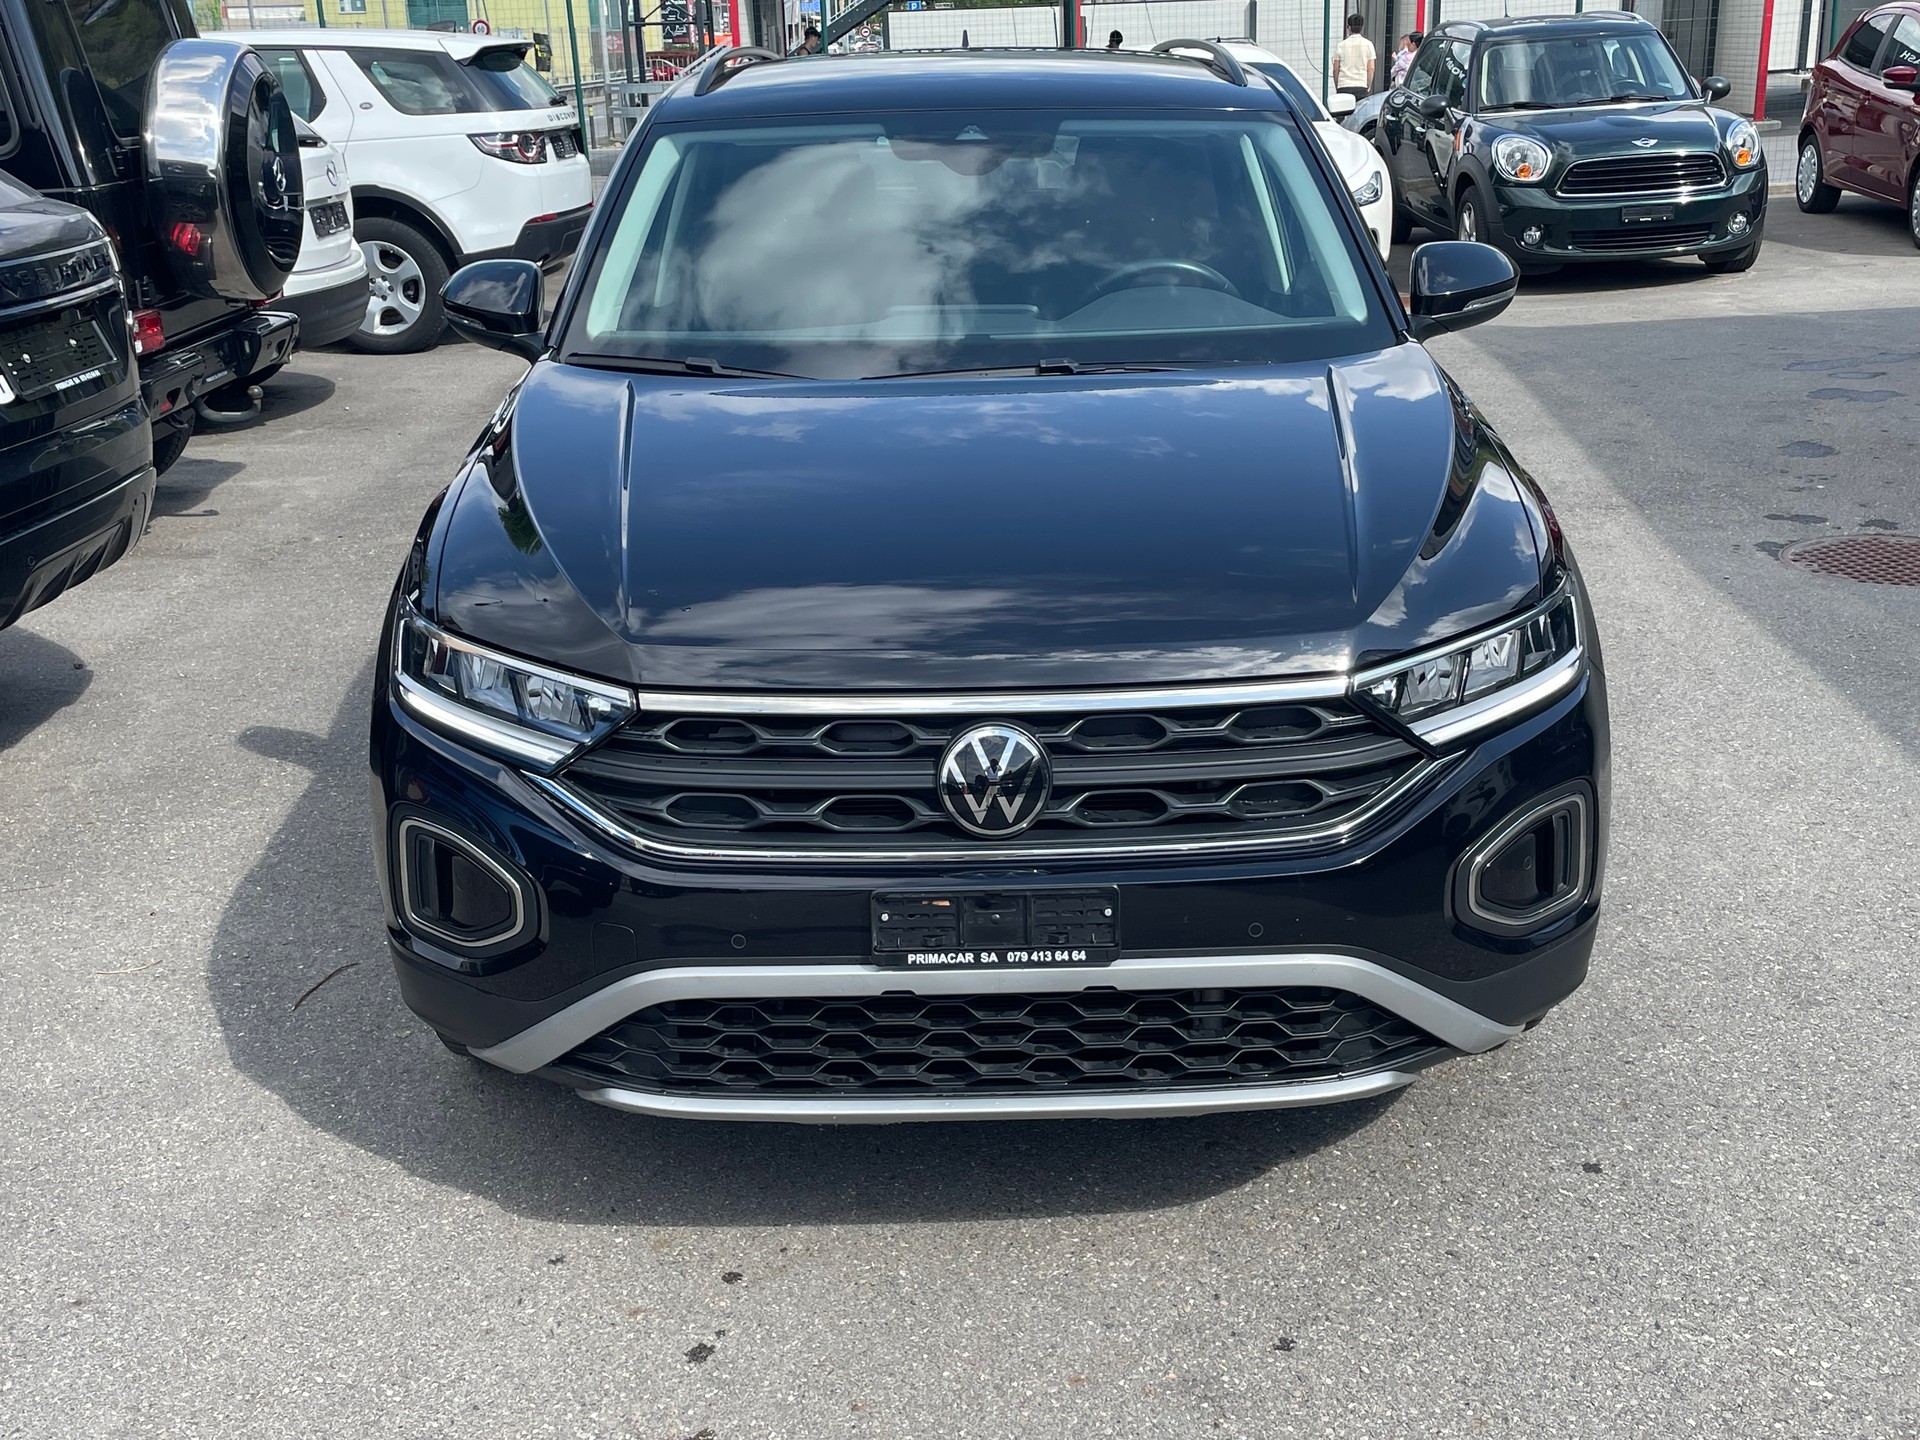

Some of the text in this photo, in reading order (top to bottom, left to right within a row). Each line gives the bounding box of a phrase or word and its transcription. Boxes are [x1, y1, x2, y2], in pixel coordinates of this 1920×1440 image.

[907, 950, 1087, 964] PRIMACAR SA 079 413 64 64
